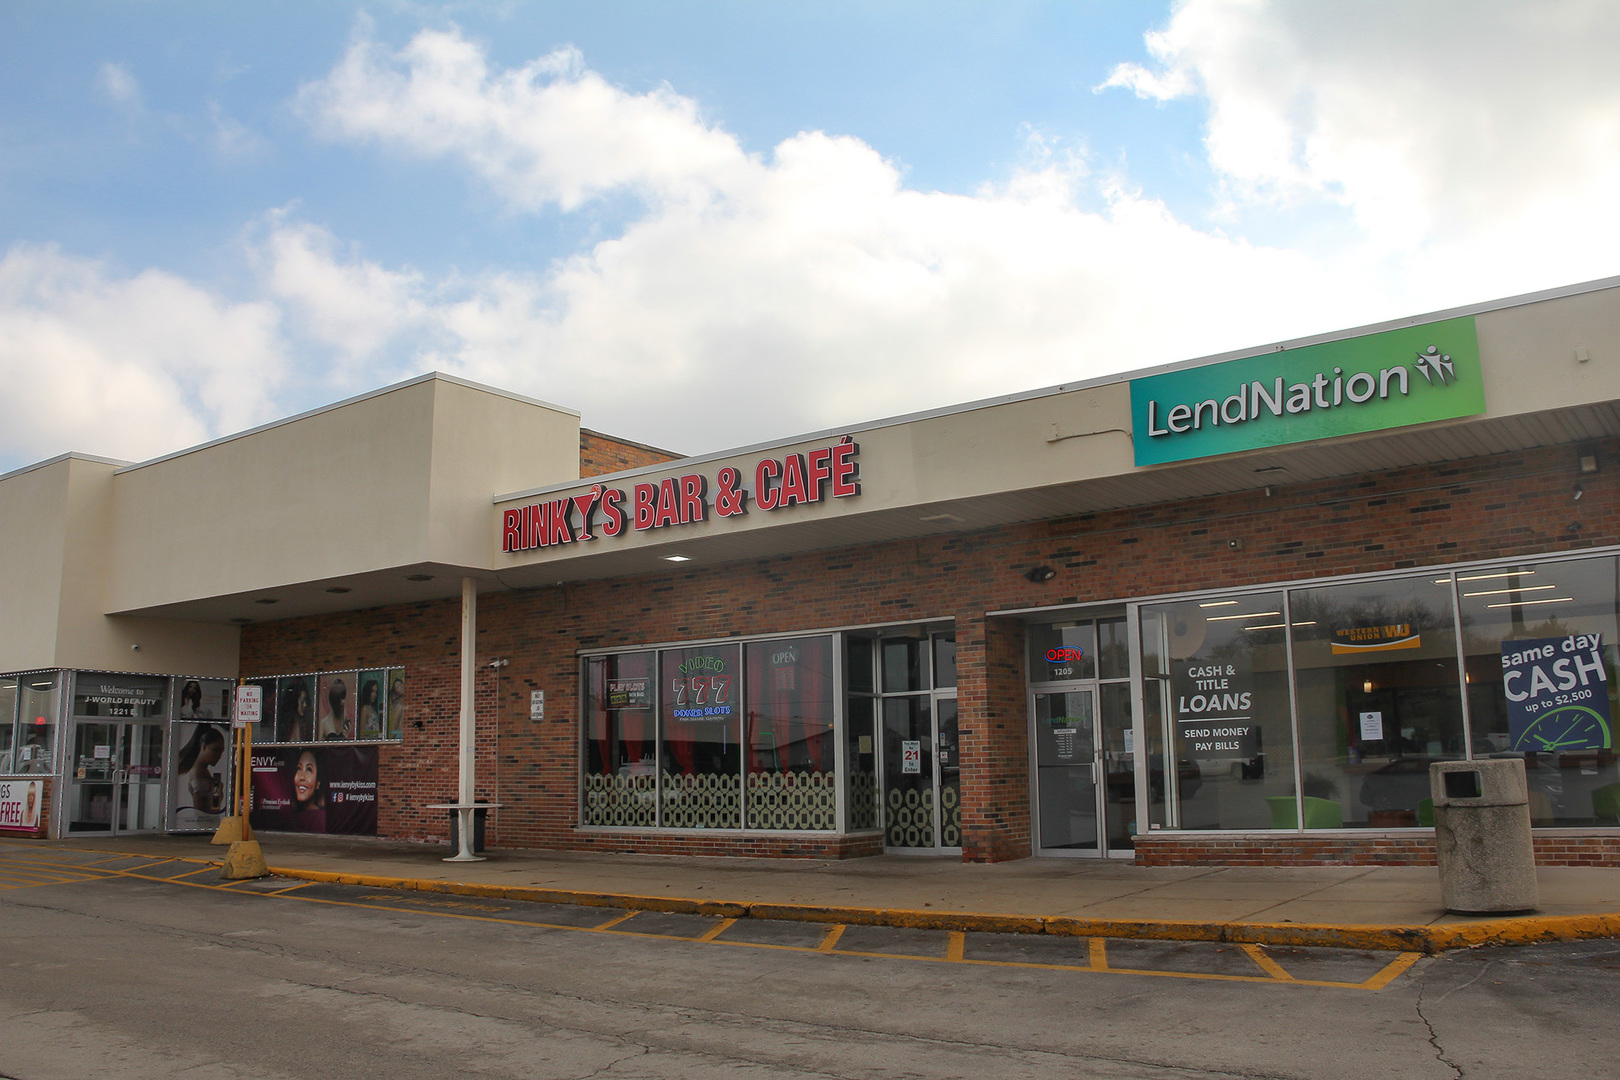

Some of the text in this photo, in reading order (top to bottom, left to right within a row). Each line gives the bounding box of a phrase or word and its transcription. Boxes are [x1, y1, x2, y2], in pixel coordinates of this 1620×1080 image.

[1148, 366, 1409, 437] LendNation
[633, 473, 705, 531] BAR
[715, 467, 746, 518] &
[755, 435, 858, 511] CAFÉ
[1336, 627, 1380, 636] WESTERN
[1350, 633, 1380, 641] UNION
[1384, 624, 1410, 638] WU
[1046, 649, 1081, 661] OPEN
[1501, 633, 1600, 668] same day
[772, 651, 796, 664] OPEN
[678, 656, 724, 673] VIDEO
[1188, 664, 1236, 678] CASH &
[1054, 668, 1073, 676] 1205
[1503, 651, 1607, 702] CASH
[100, 685, 134, 695] Welcome
[626, 682, 645, 691] SLOTS
[672, 674, 732, 705] 777
[1196, 679, 1229, 691] TITLE
[1179, 692, 1252, 713] LOANS
[1525, 689, 1593, 713] up to $2,500
[704, 706, 731, 716] SLOTS
[1184, 727, 1249, 738] SEND MONEY
[1195, 741, 1240, 751] PAY BILLS
[905, 750, 918, 760] 21
[0, 784, 10, 798] GS
[0, 802, 21, 822] FREE
